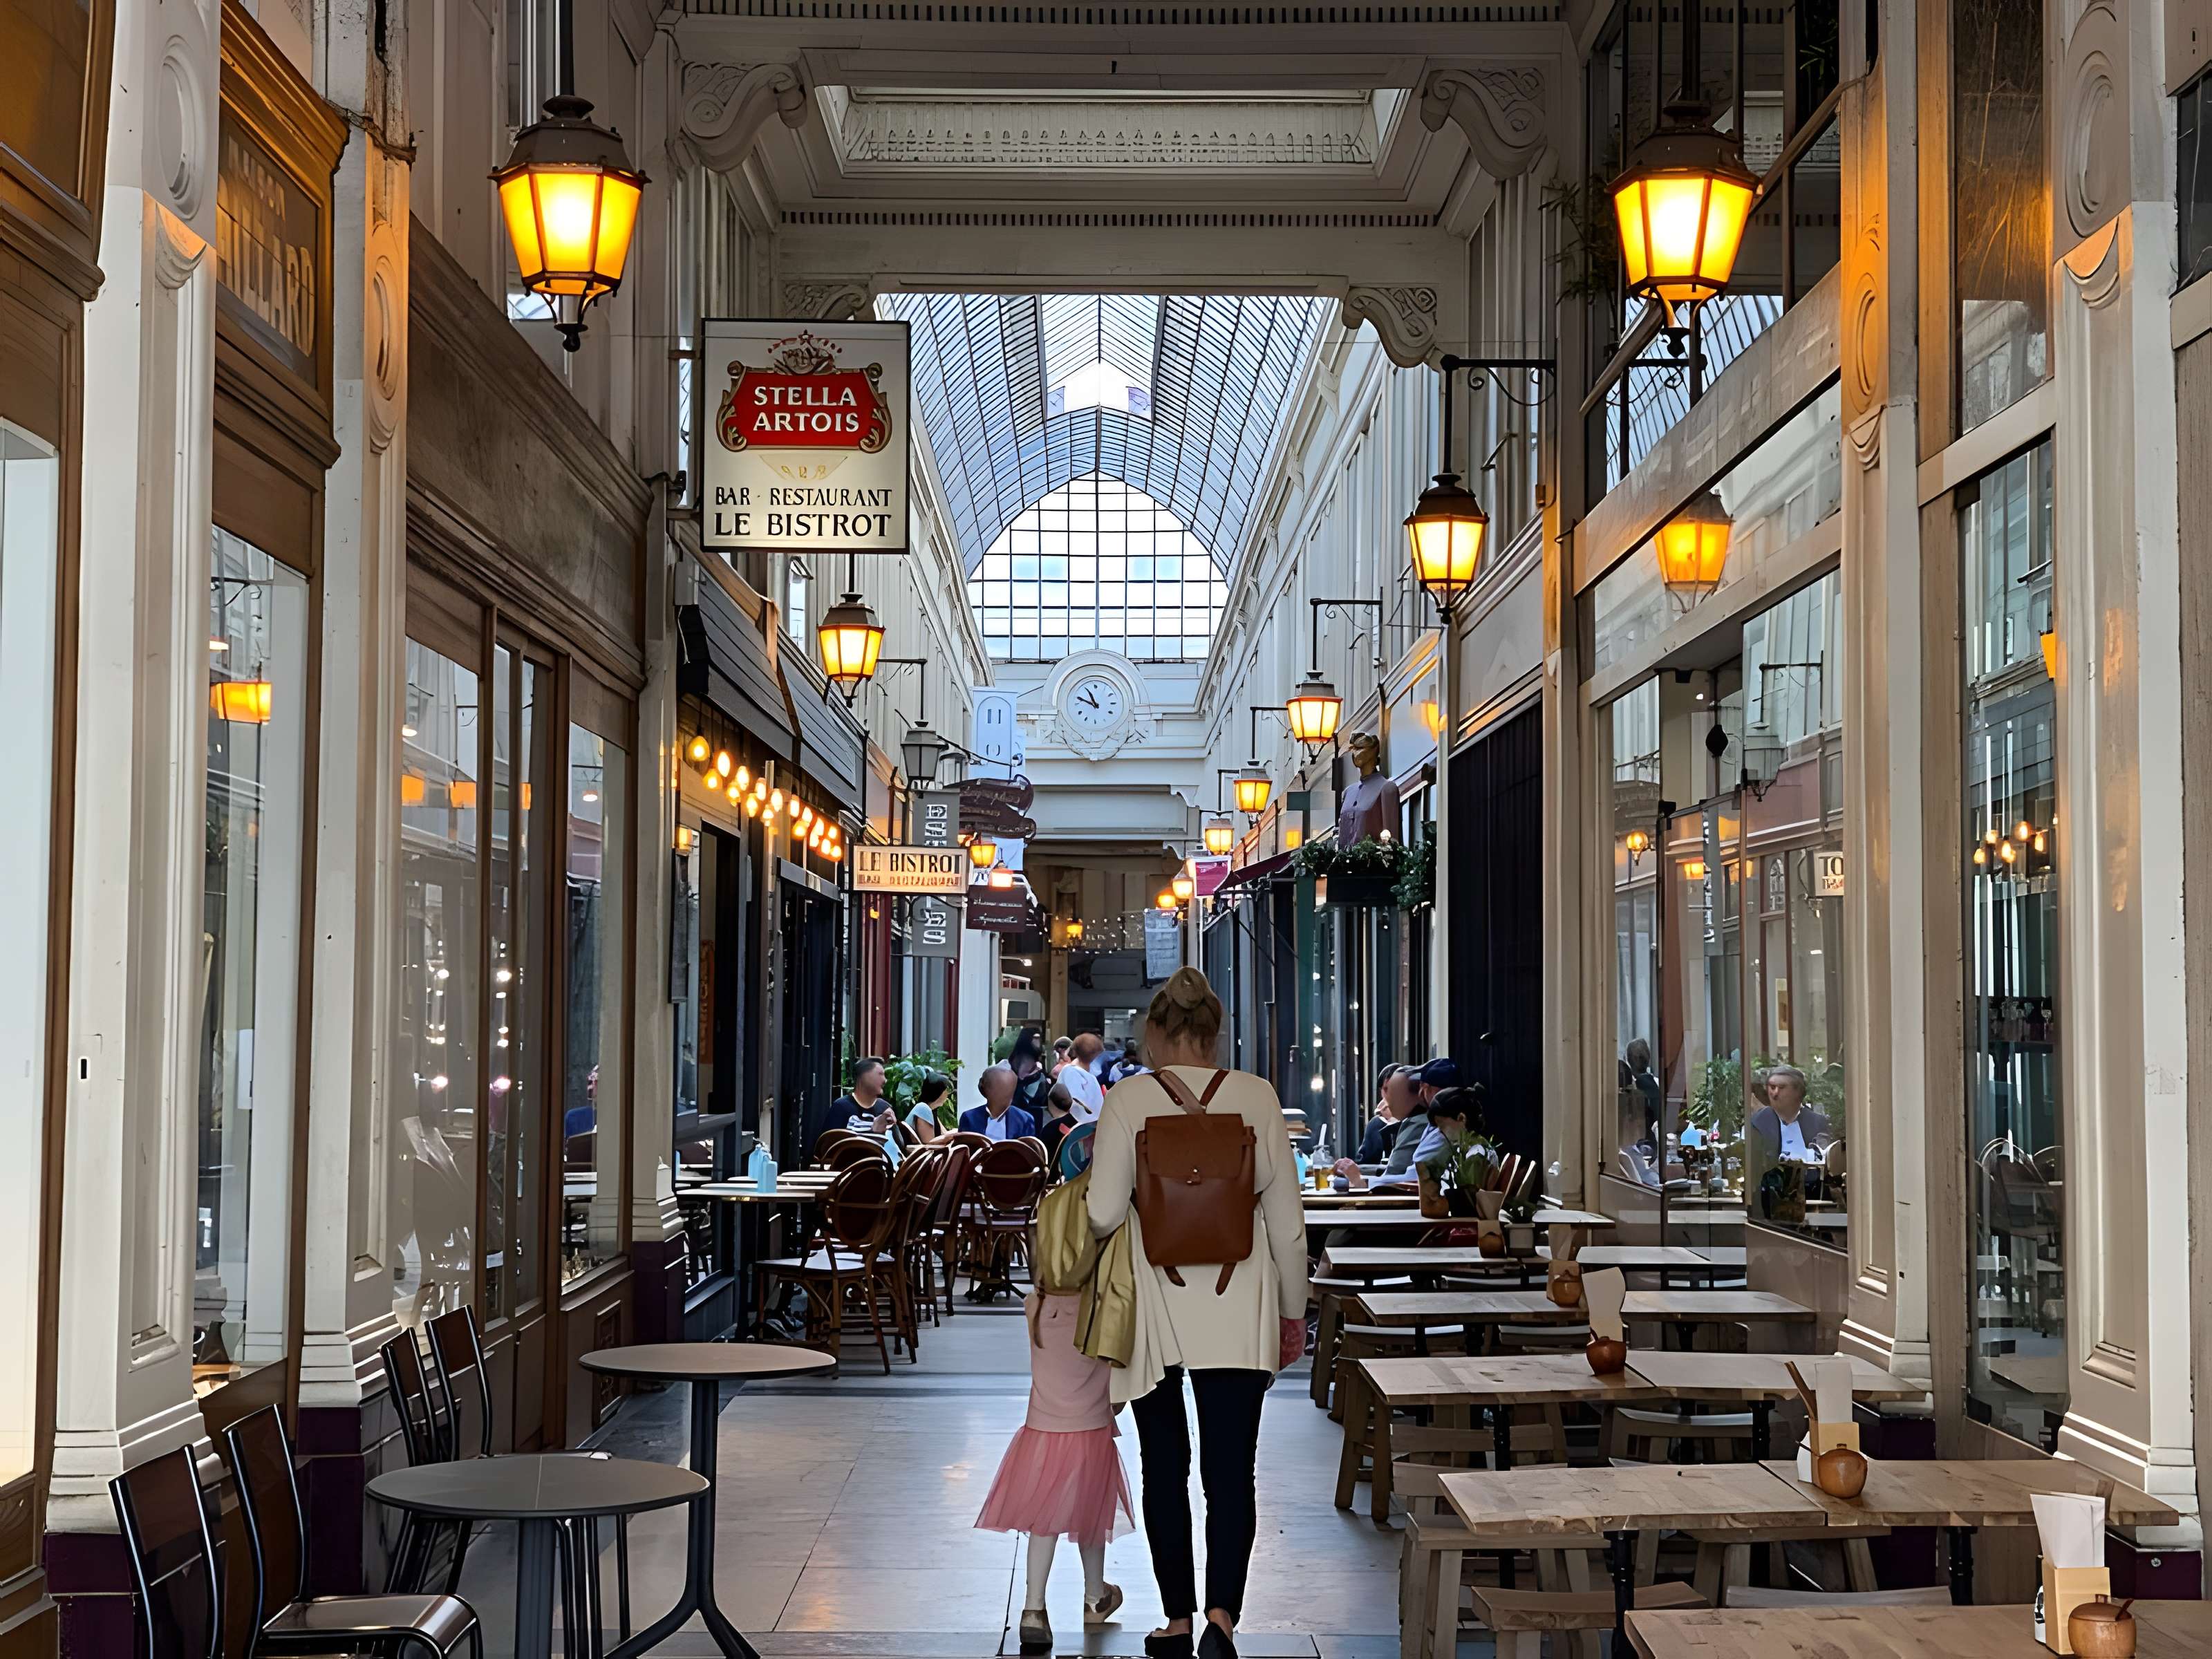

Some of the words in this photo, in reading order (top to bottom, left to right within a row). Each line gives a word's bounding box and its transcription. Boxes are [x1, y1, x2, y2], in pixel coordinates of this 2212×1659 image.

[754, 386, 856, 405] STELLA
[753, 412, 859, 432] ARTOIS
[715, 487, 751, 505] BAR
[769, 489, 892, 506] RESTAURANT
[715, 513, 751, 536] LE
[767, 514, 892, 537] BISTROT
[859, 851, 881, 871] LE
